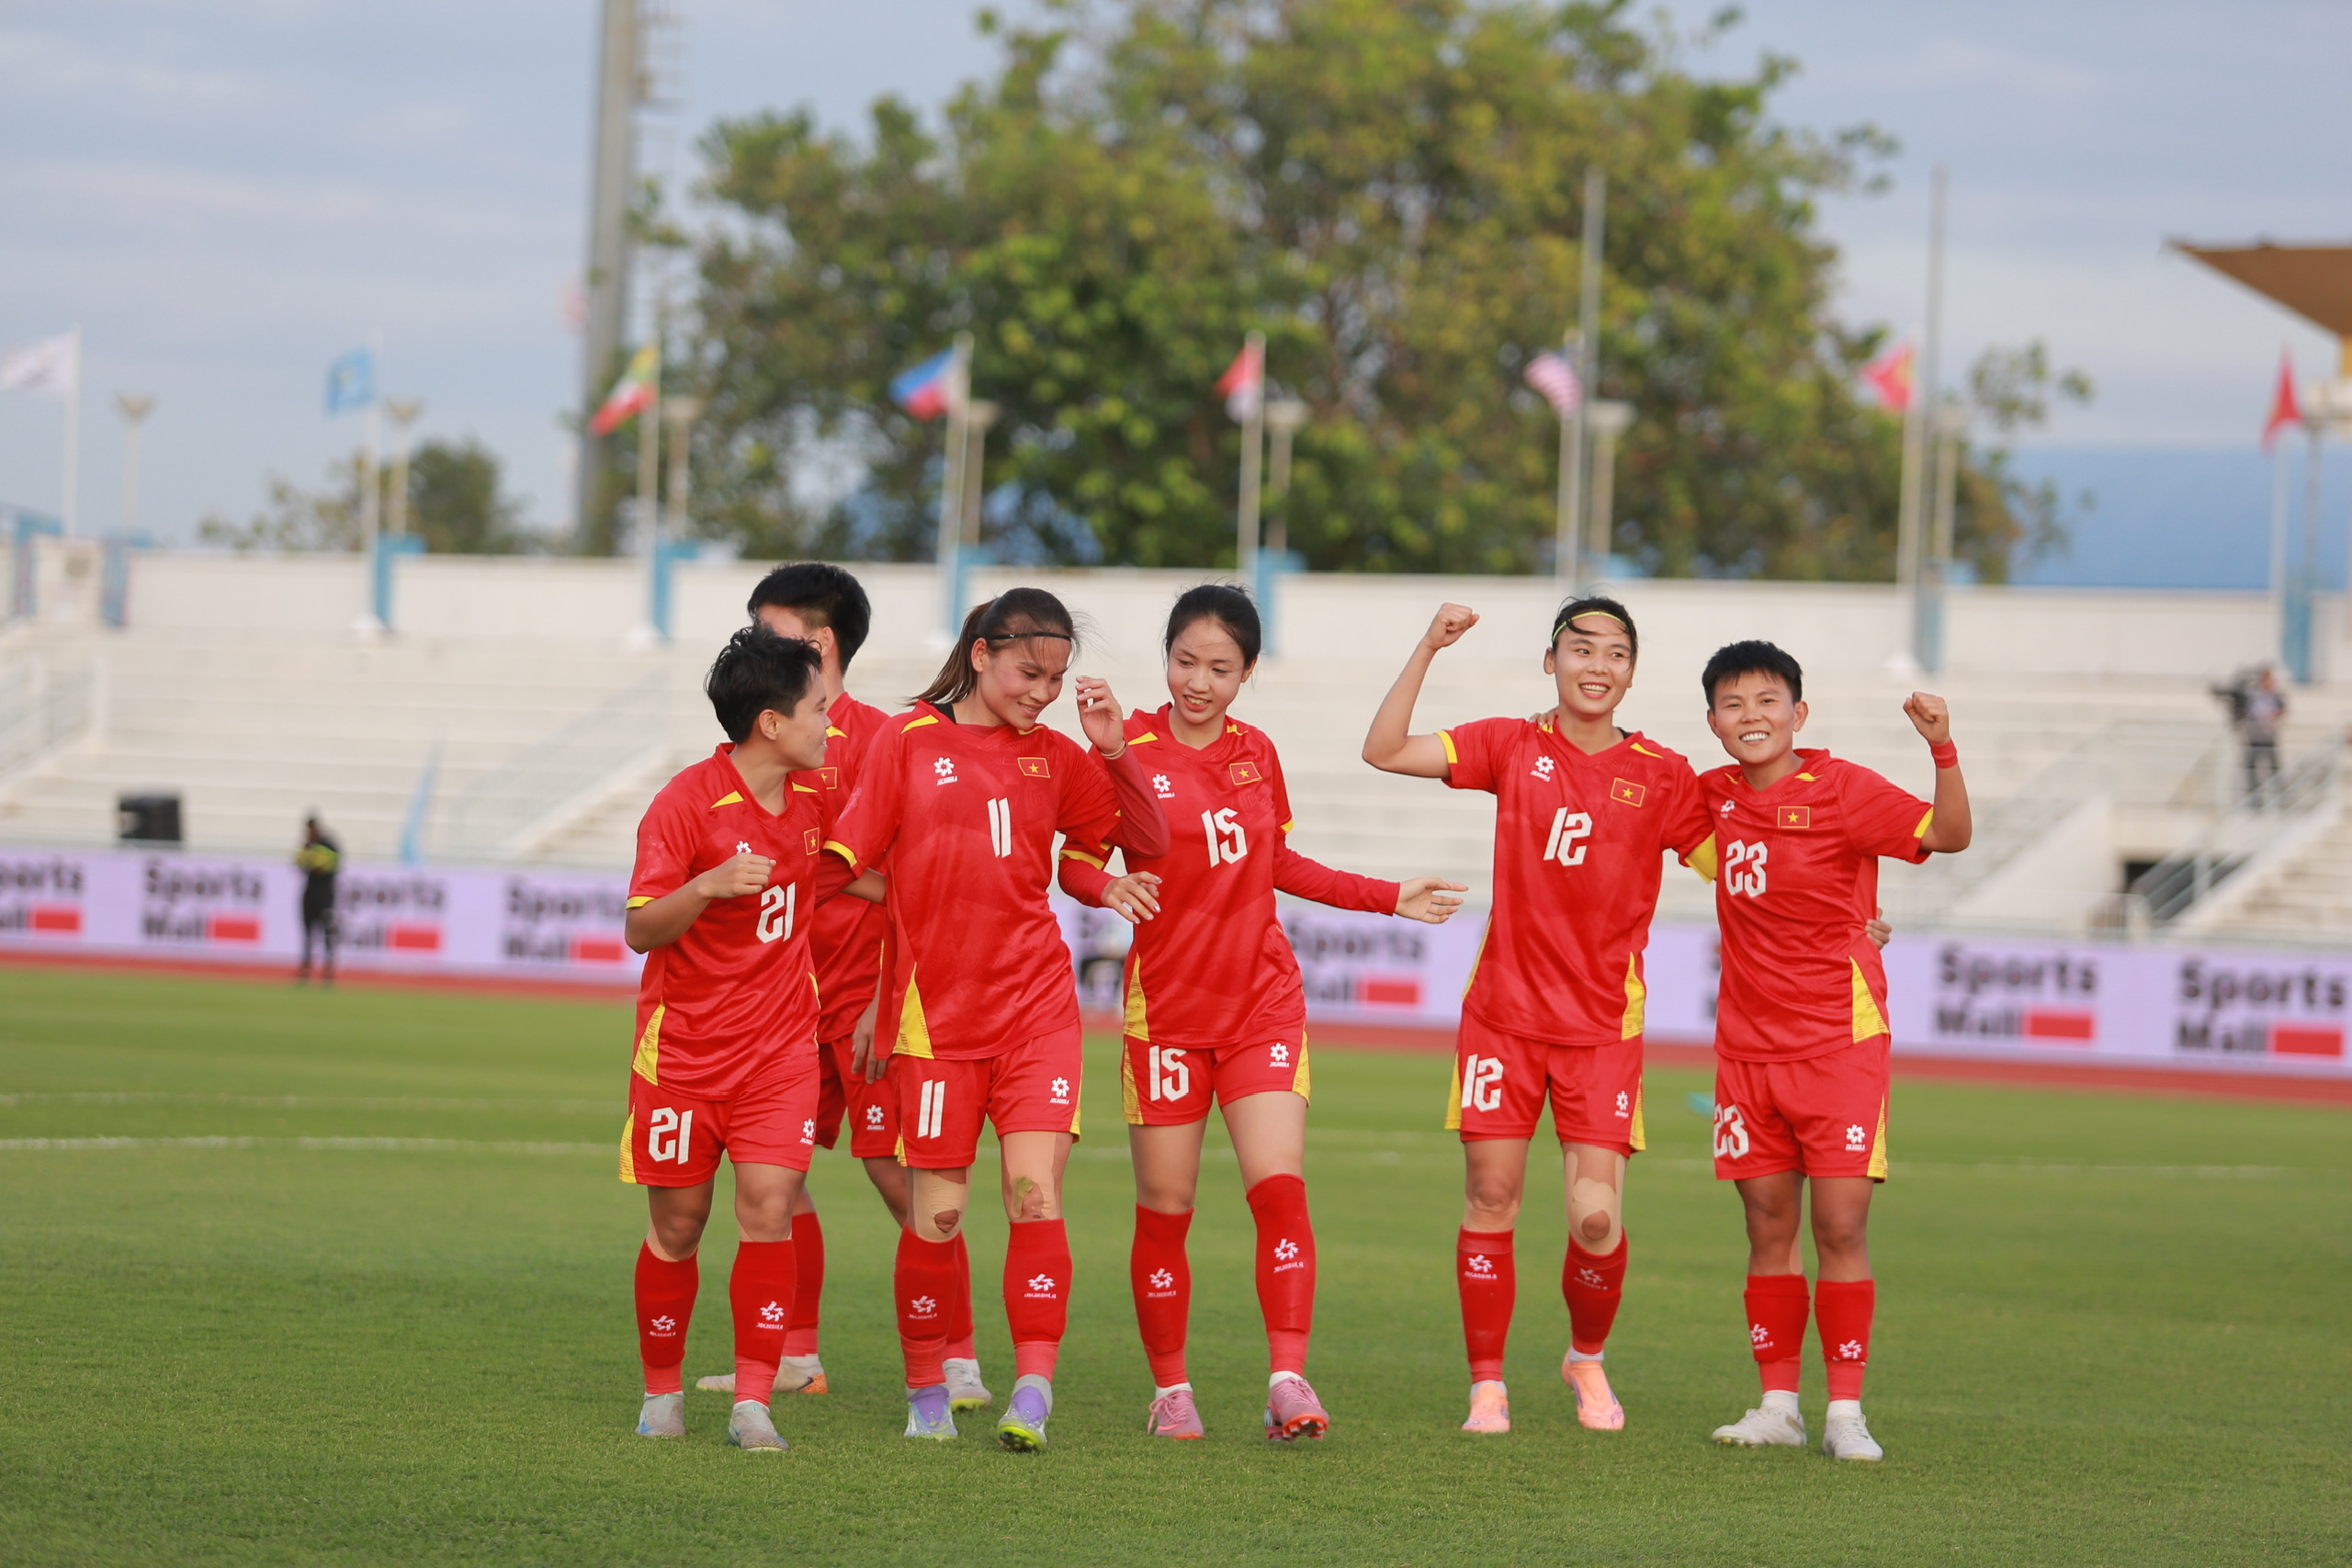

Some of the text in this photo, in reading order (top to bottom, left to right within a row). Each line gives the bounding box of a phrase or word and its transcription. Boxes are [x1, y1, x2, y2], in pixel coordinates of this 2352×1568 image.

[987, 797, 1011, 858] 11
[1201, 807, 1248, 868] 15
[1543, 807, 1592, 866] 12
[1724, 840, 1768, 897] 23
[756, 882, 796, 943] 21
[1938, 942, 2098, 994] Sports
[2179, 958, 2348, 1010] Sports
[1148, 1045, 1189, 1101] 15
[1461, 1054, 1503, 1111] 12
[649, 1106, 693, 1165] 21
[918, 1079, 945, 1139] 11
[1713, 1104, 1749, 1159] 23
